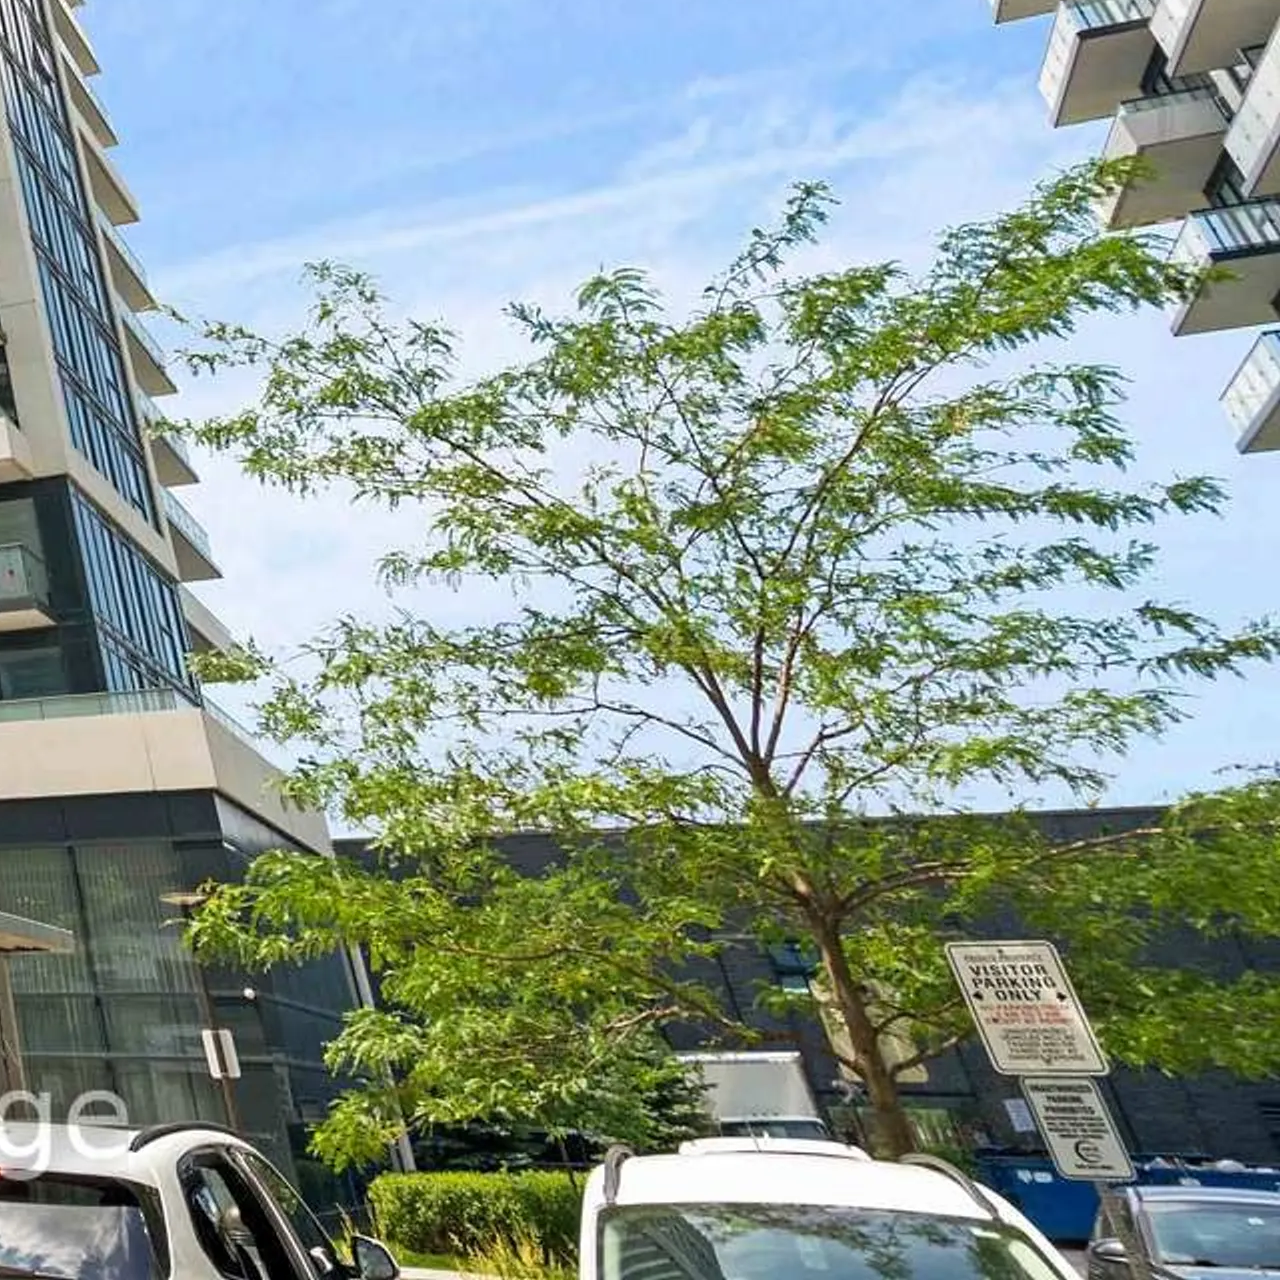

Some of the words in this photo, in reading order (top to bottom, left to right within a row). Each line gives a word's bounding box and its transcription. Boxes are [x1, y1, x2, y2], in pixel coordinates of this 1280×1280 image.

[968, 963, 1048, 977] VISITOR
[972, 977, 1058, 990] PARKING
[995, 989, 1042, 1002] ONLY
